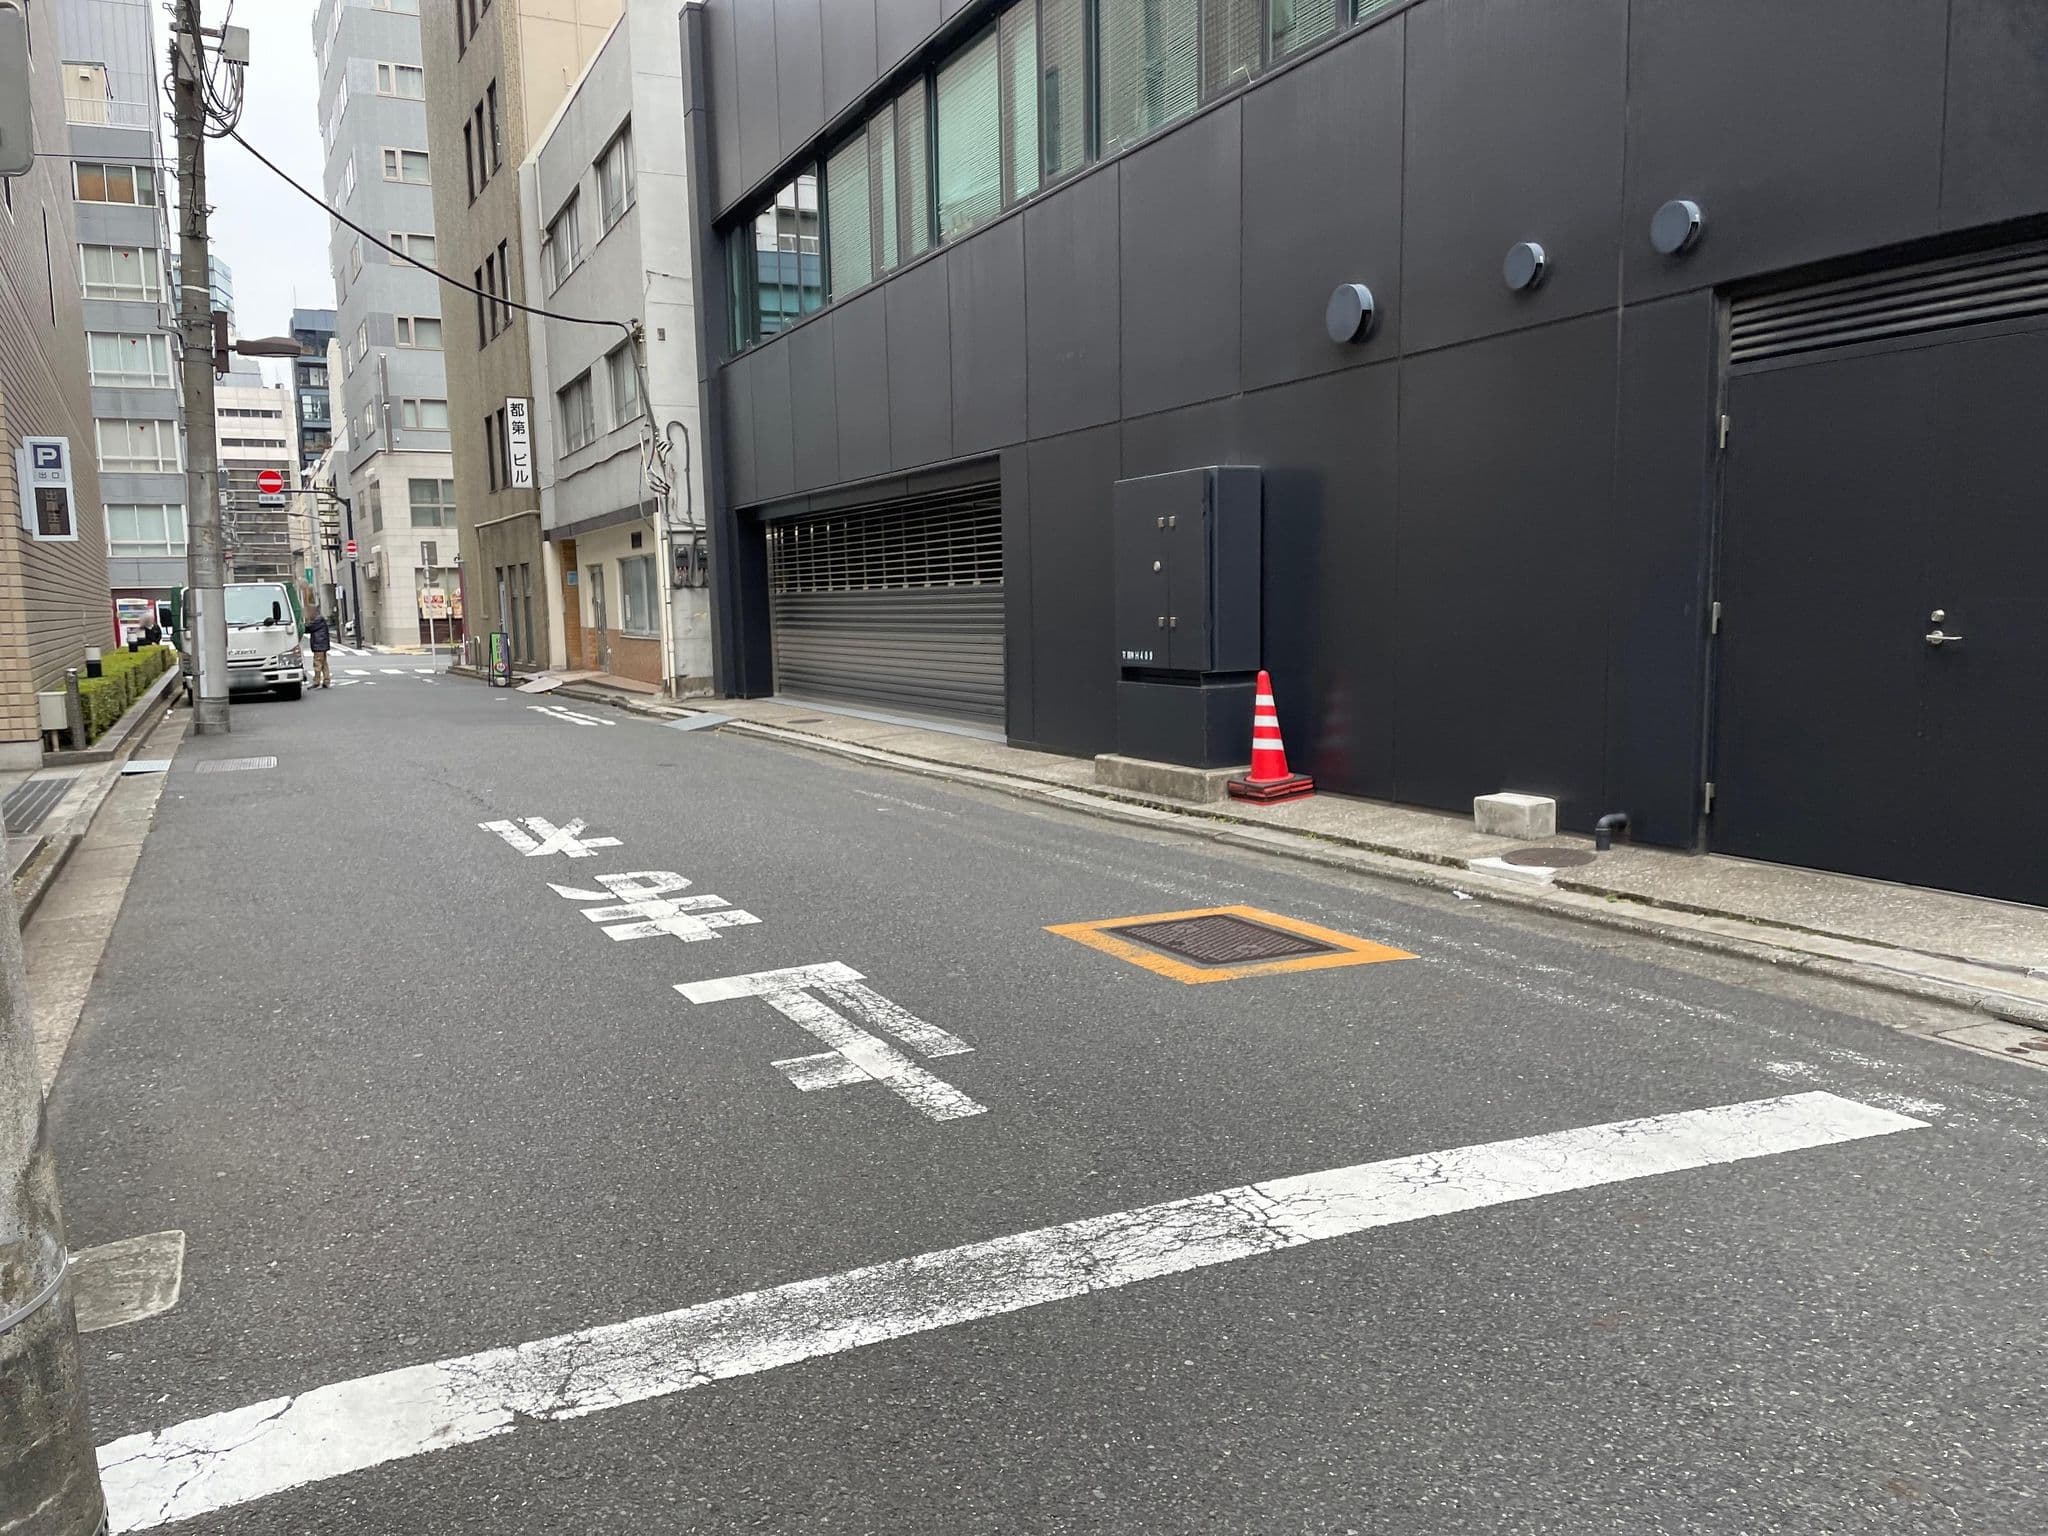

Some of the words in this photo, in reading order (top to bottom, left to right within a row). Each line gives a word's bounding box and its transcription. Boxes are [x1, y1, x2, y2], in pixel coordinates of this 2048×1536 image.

[36, 447, 58, 466] P
[509, 402, 529, 484] 都第一ビル
[38, 471, 60, 480] 出口
[478, 815, 991, 1123] 止まれ
